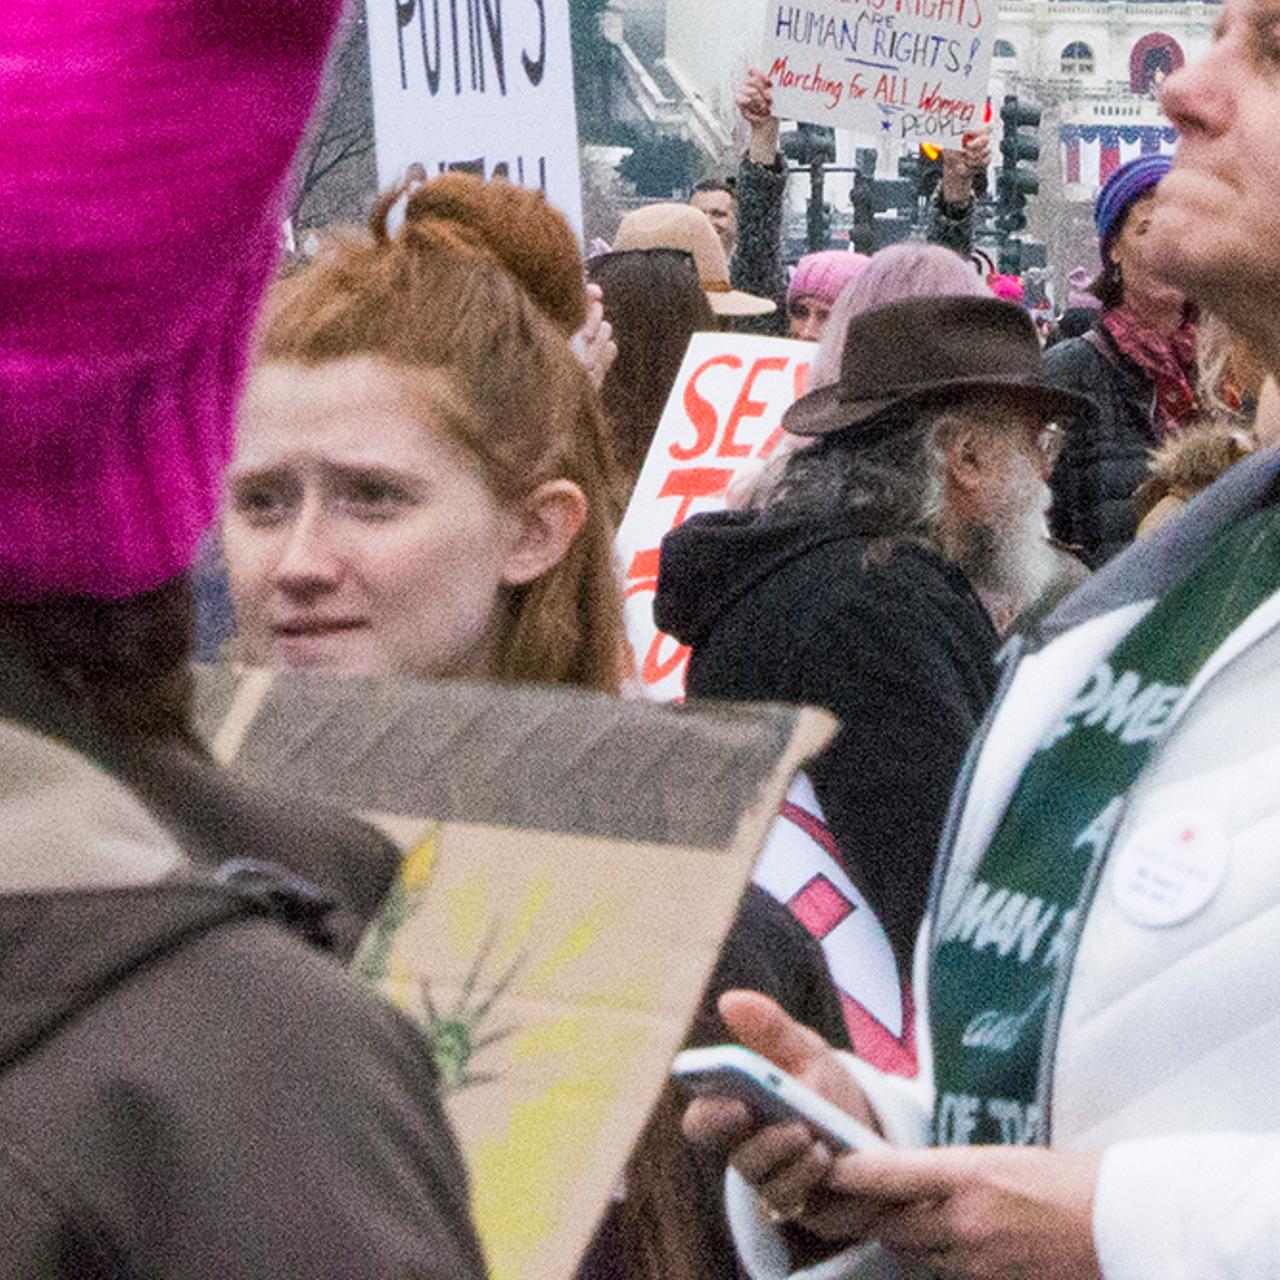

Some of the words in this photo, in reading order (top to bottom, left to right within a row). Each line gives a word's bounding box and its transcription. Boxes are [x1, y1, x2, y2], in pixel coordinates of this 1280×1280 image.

[775, 5, 859, 53] HUMAN
[872, 27, 982, 77] RIGHTS!
[857, 10, 897, 28] ARE
[768, 55, 844, 110] Marching
[848, 72, 869, 100] for
[873, 73, 910, 105] ALL
